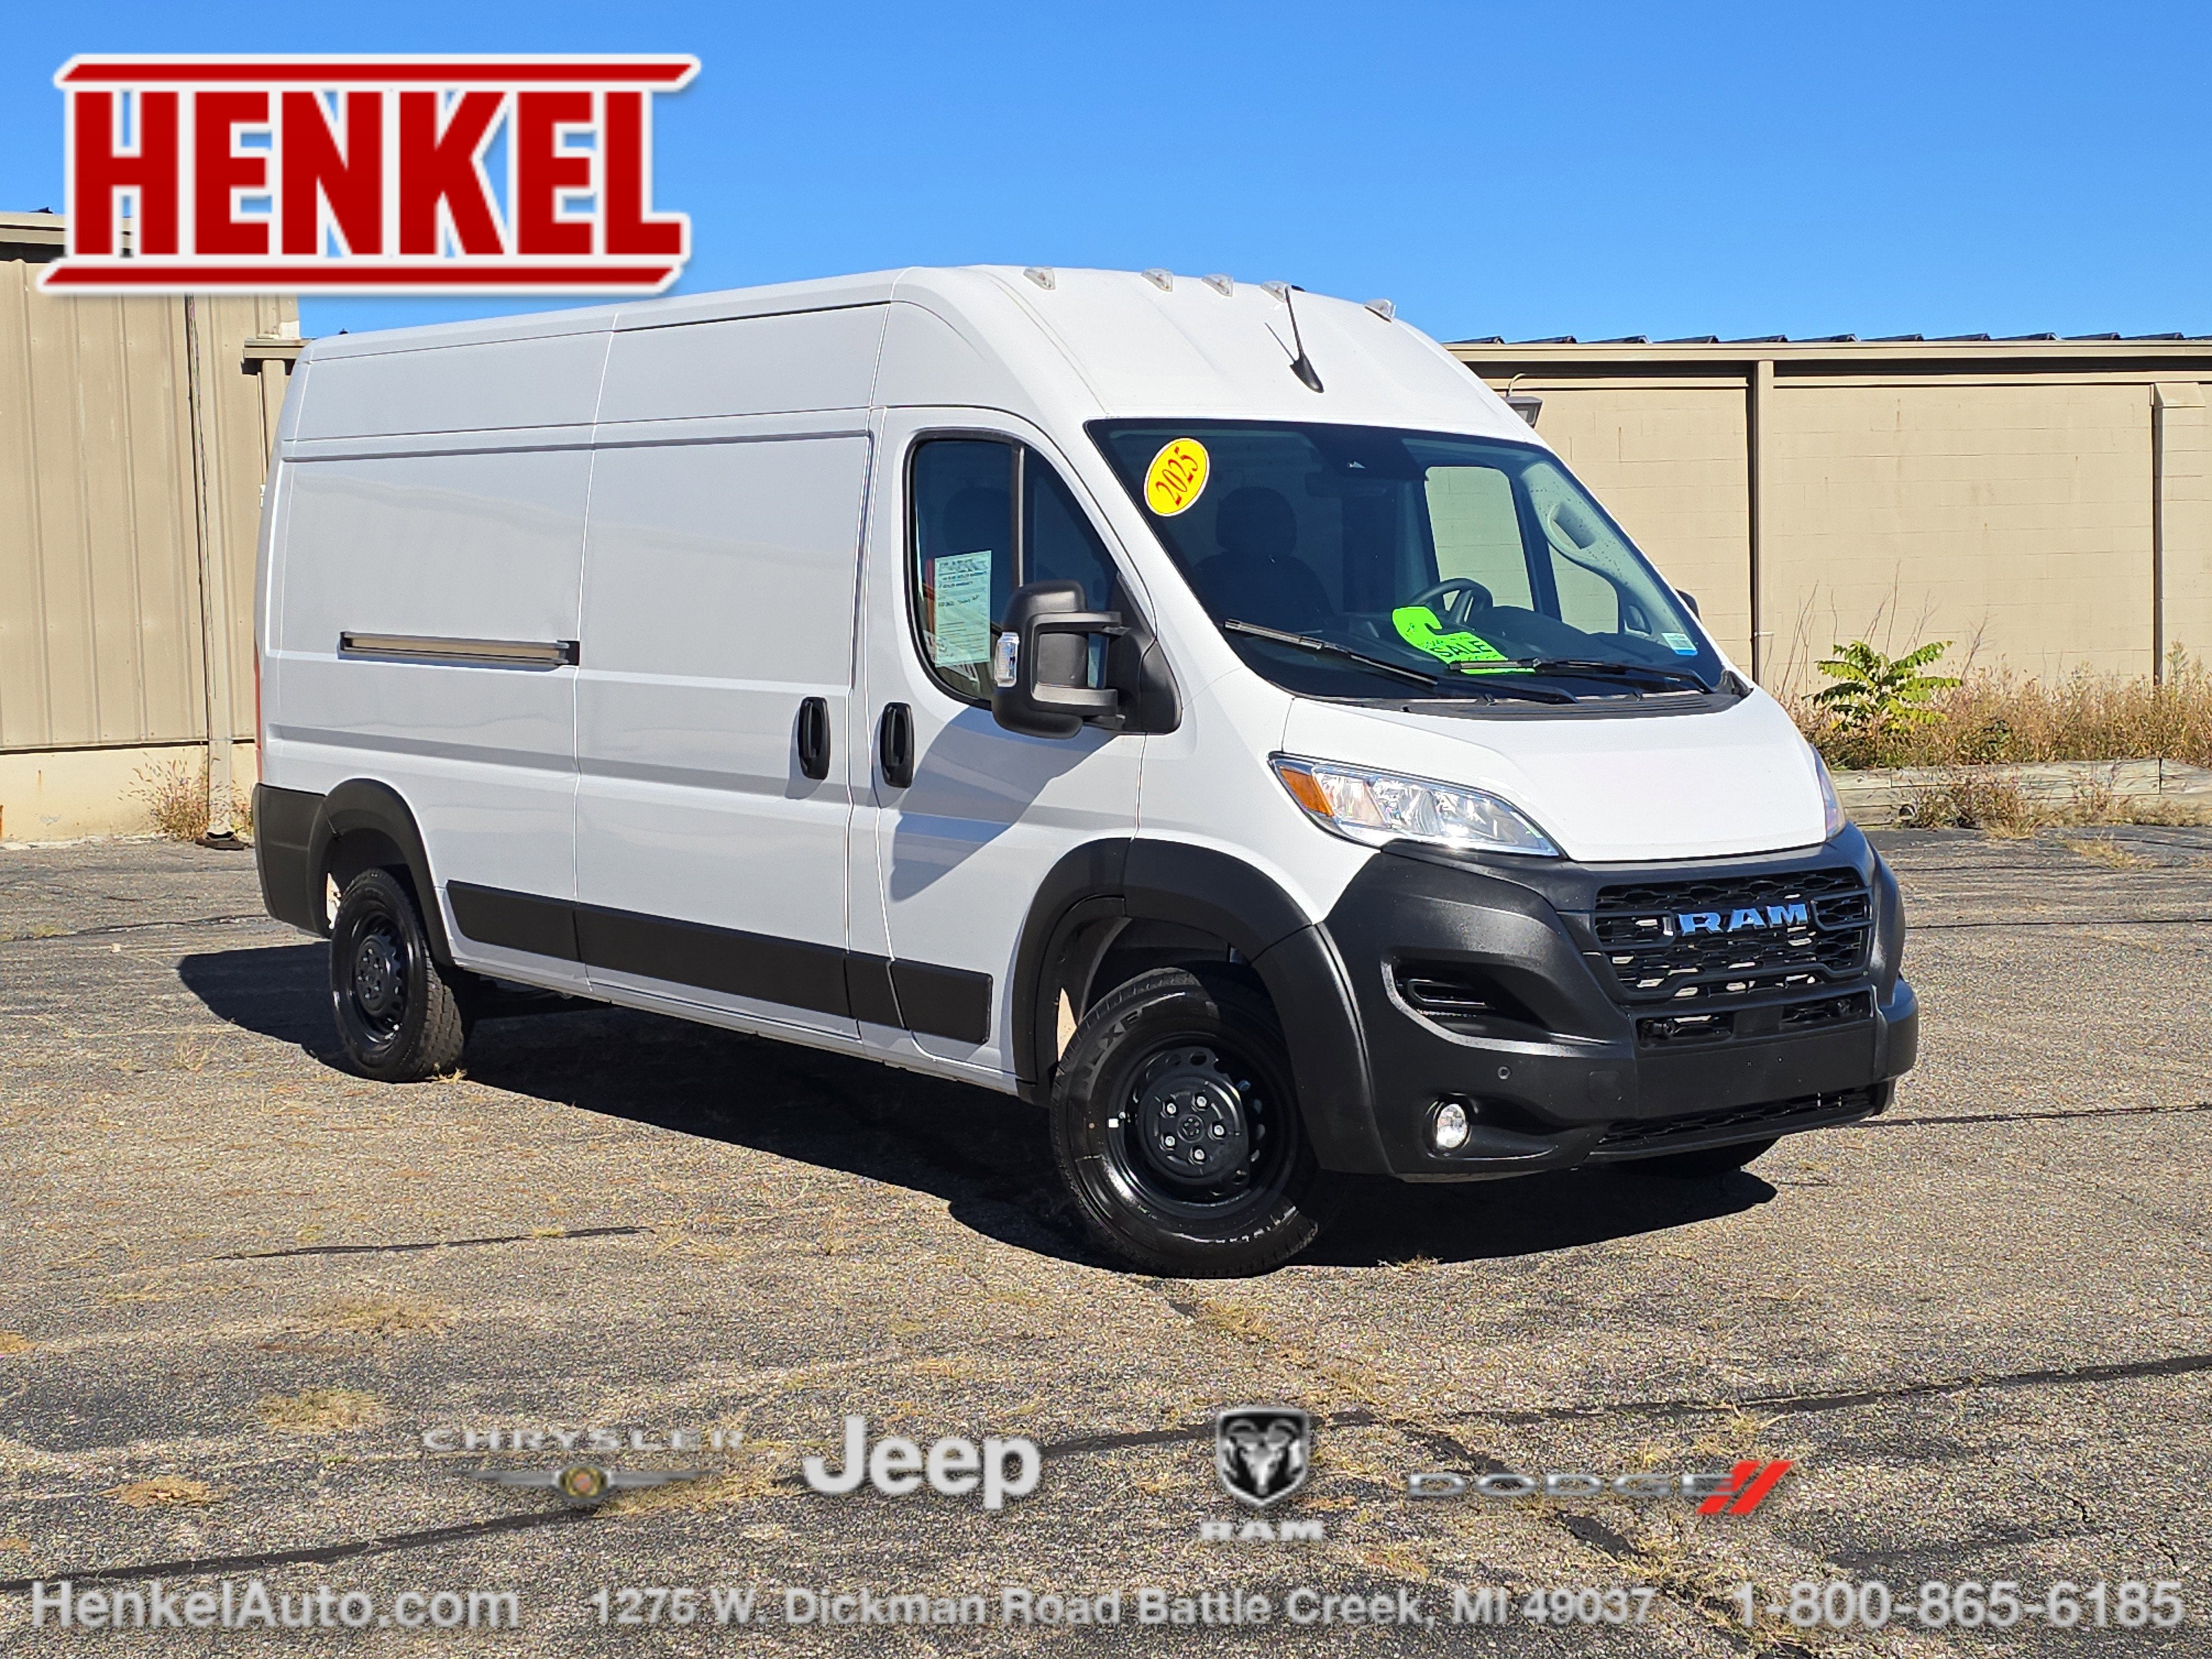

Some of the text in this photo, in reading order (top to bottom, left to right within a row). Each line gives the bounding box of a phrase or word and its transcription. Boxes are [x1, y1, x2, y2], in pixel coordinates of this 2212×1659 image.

[1155, 446, 1199, 506] 2025
[1428, 640, 1493, 658] SALE
[1679, 903, 1809, 937] RAM
